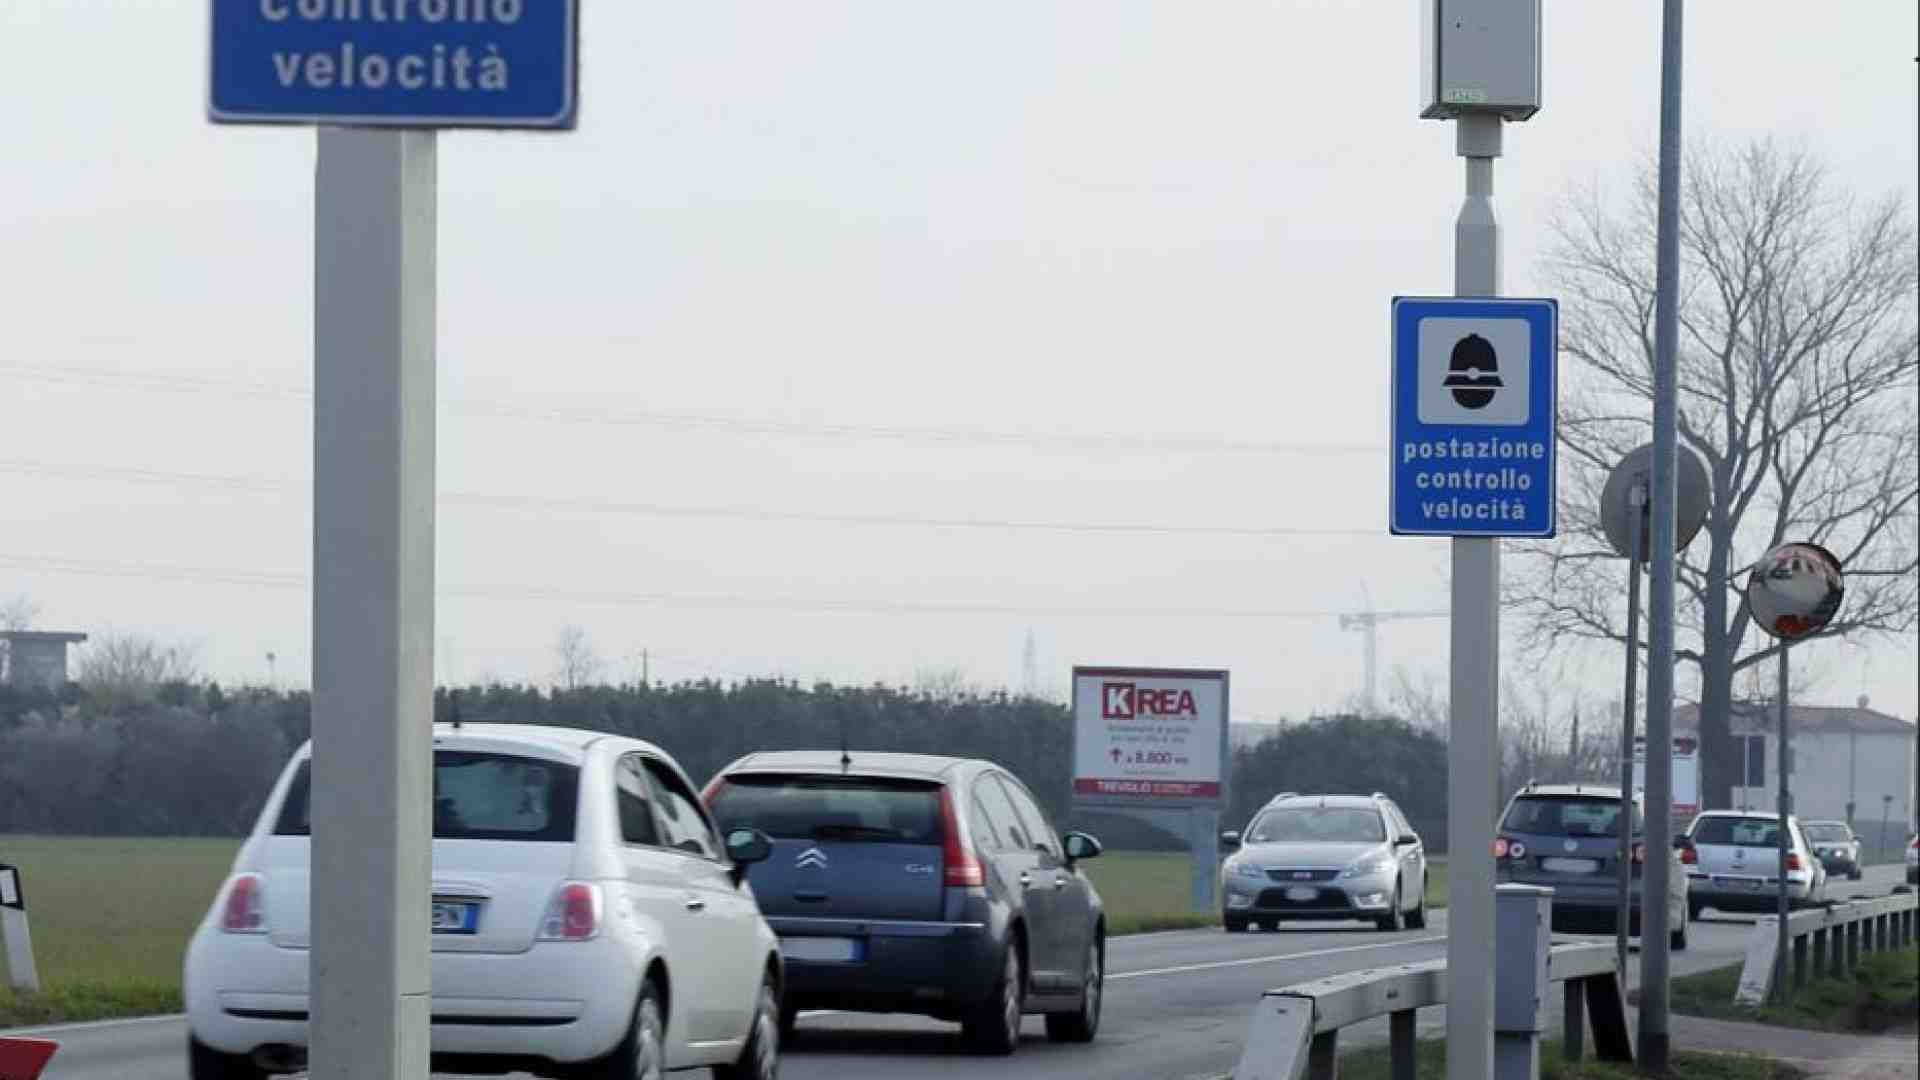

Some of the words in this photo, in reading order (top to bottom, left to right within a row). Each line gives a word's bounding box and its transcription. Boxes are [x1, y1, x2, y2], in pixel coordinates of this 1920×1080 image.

[273, 42, 508, 90] velocità
[1403, 437, 1545, 464] postazione
[1415, 468, 1532, 491] controllo
[1421, 498, 1527, 521] velocità
[1103, 684, 1198, 718] KREA
